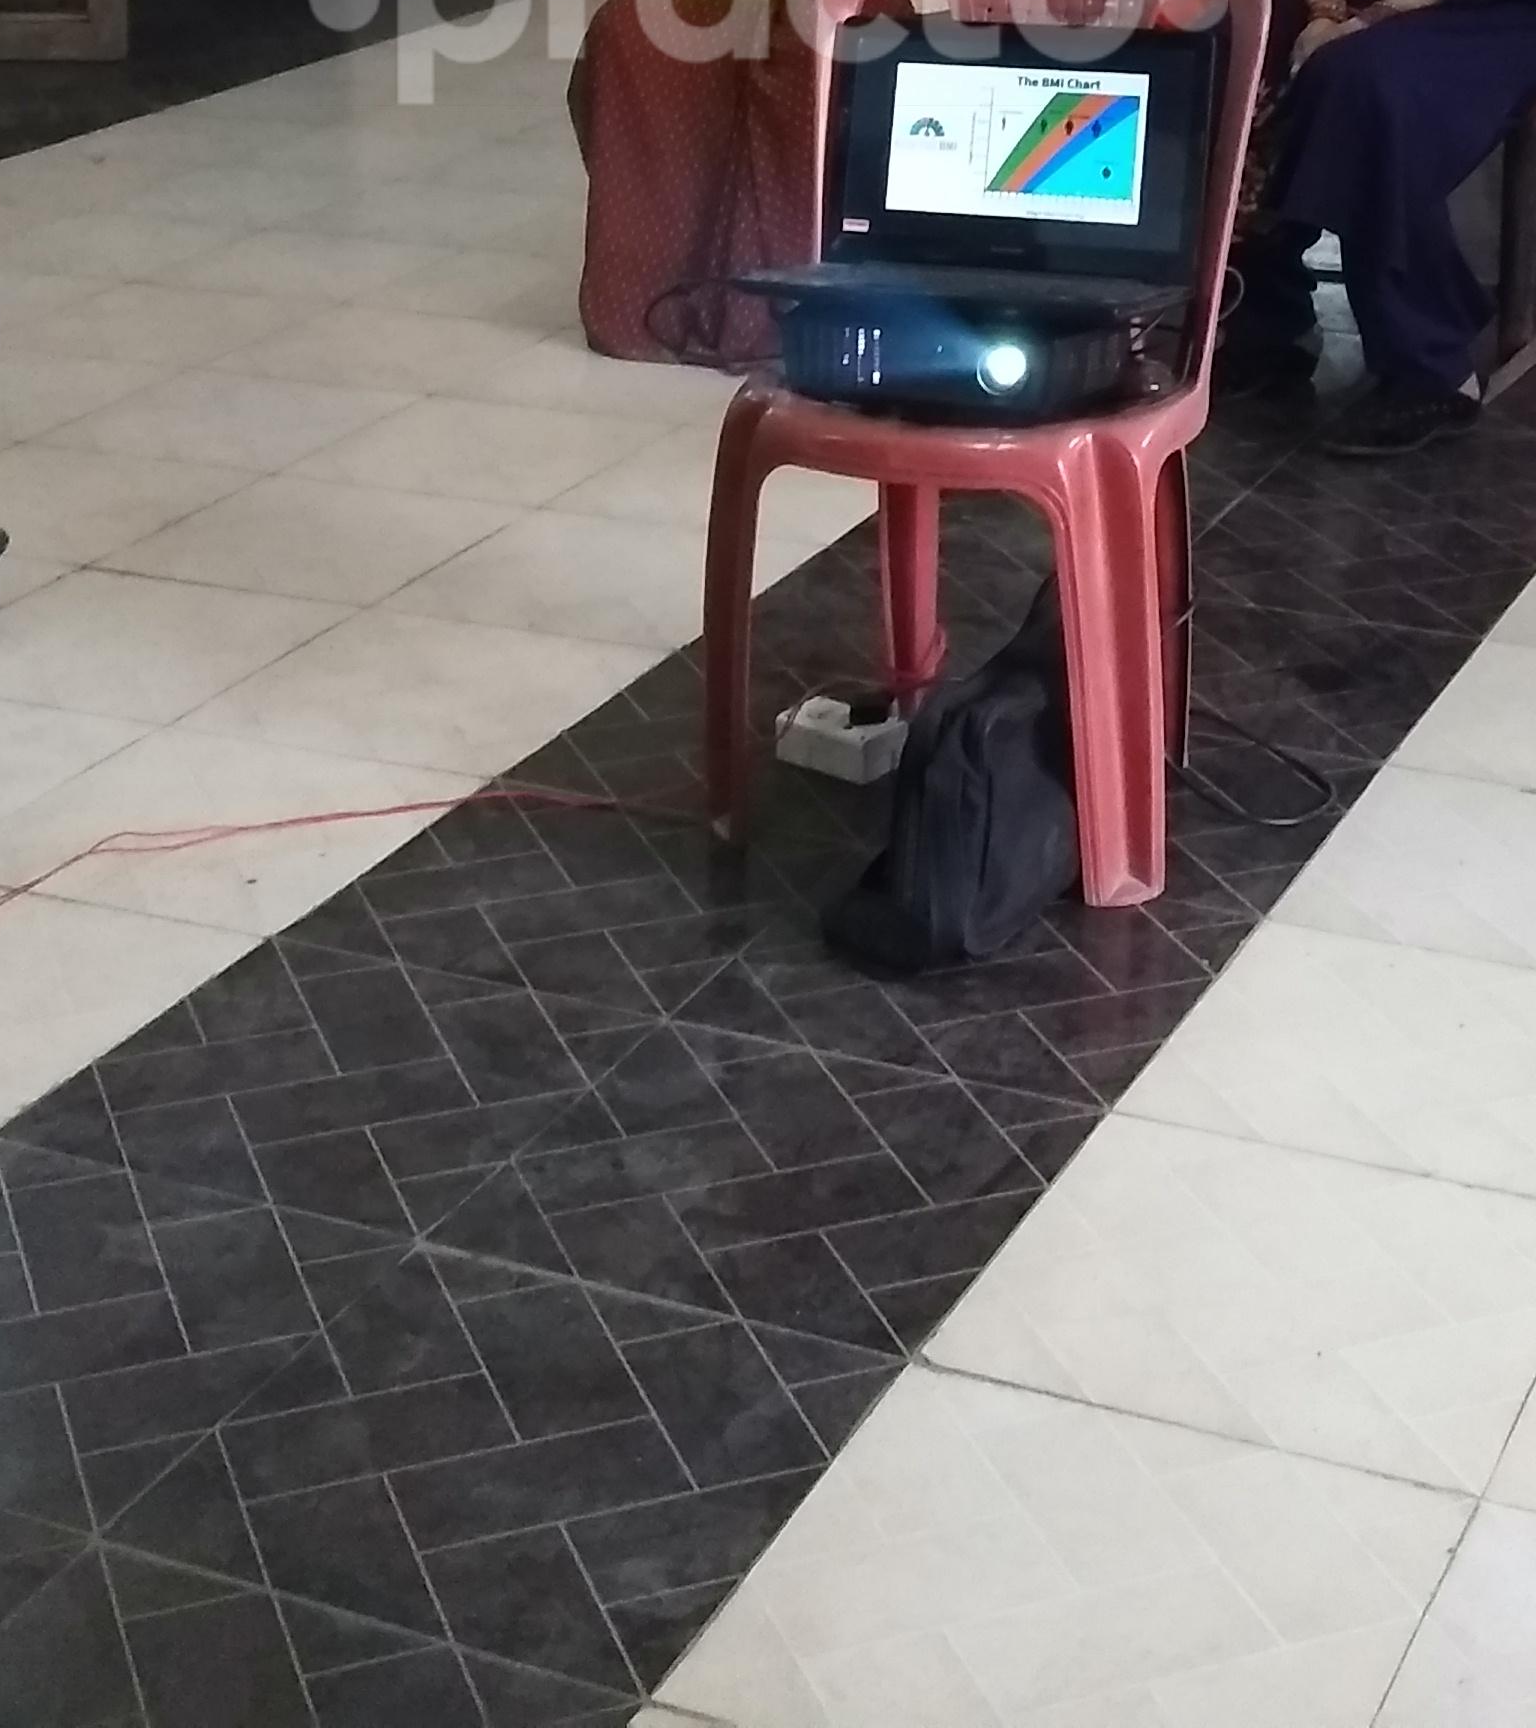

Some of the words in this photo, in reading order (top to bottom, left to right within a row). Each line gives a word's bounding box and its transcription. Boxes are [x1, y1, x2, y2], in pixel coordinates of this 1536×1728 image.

[1017, 76, 1039, 88] The
[1041, 77, 1065, 89] BMI
[1067, 78, 1101, 91] Chart
